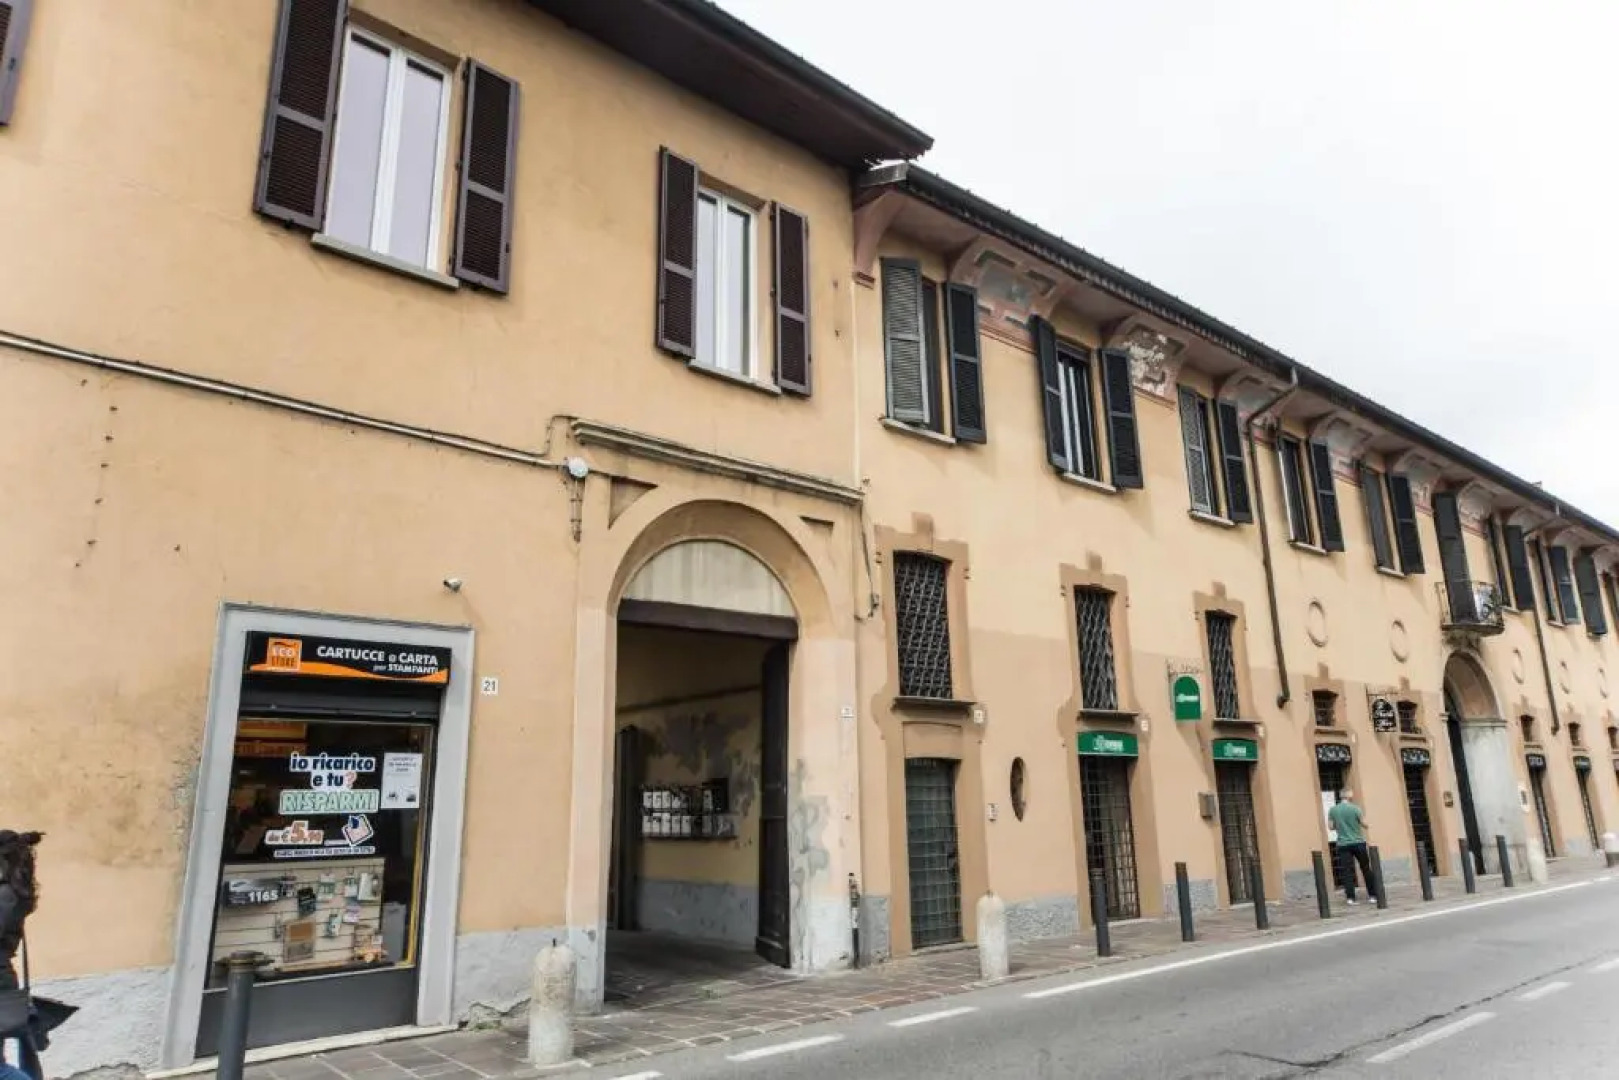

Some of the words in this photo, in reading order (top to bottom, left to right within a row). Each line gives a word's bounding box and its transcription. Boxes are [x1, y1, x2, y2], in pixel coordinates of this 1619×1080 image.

[316, 646, 385, 662] CARTUCCE
[399, 652, 439, 665] CARTA
[388, 663, 439, 674] STAMPANTI
[483, 680, 496, 691] 21
[291, 753, 308, 770] io
[312, 754, 374, 771] ricarico
[312, 775, 323, 787] e
[281, 792, 377, 813] RISPARMI
[249, 890, 279, 903] 1165
